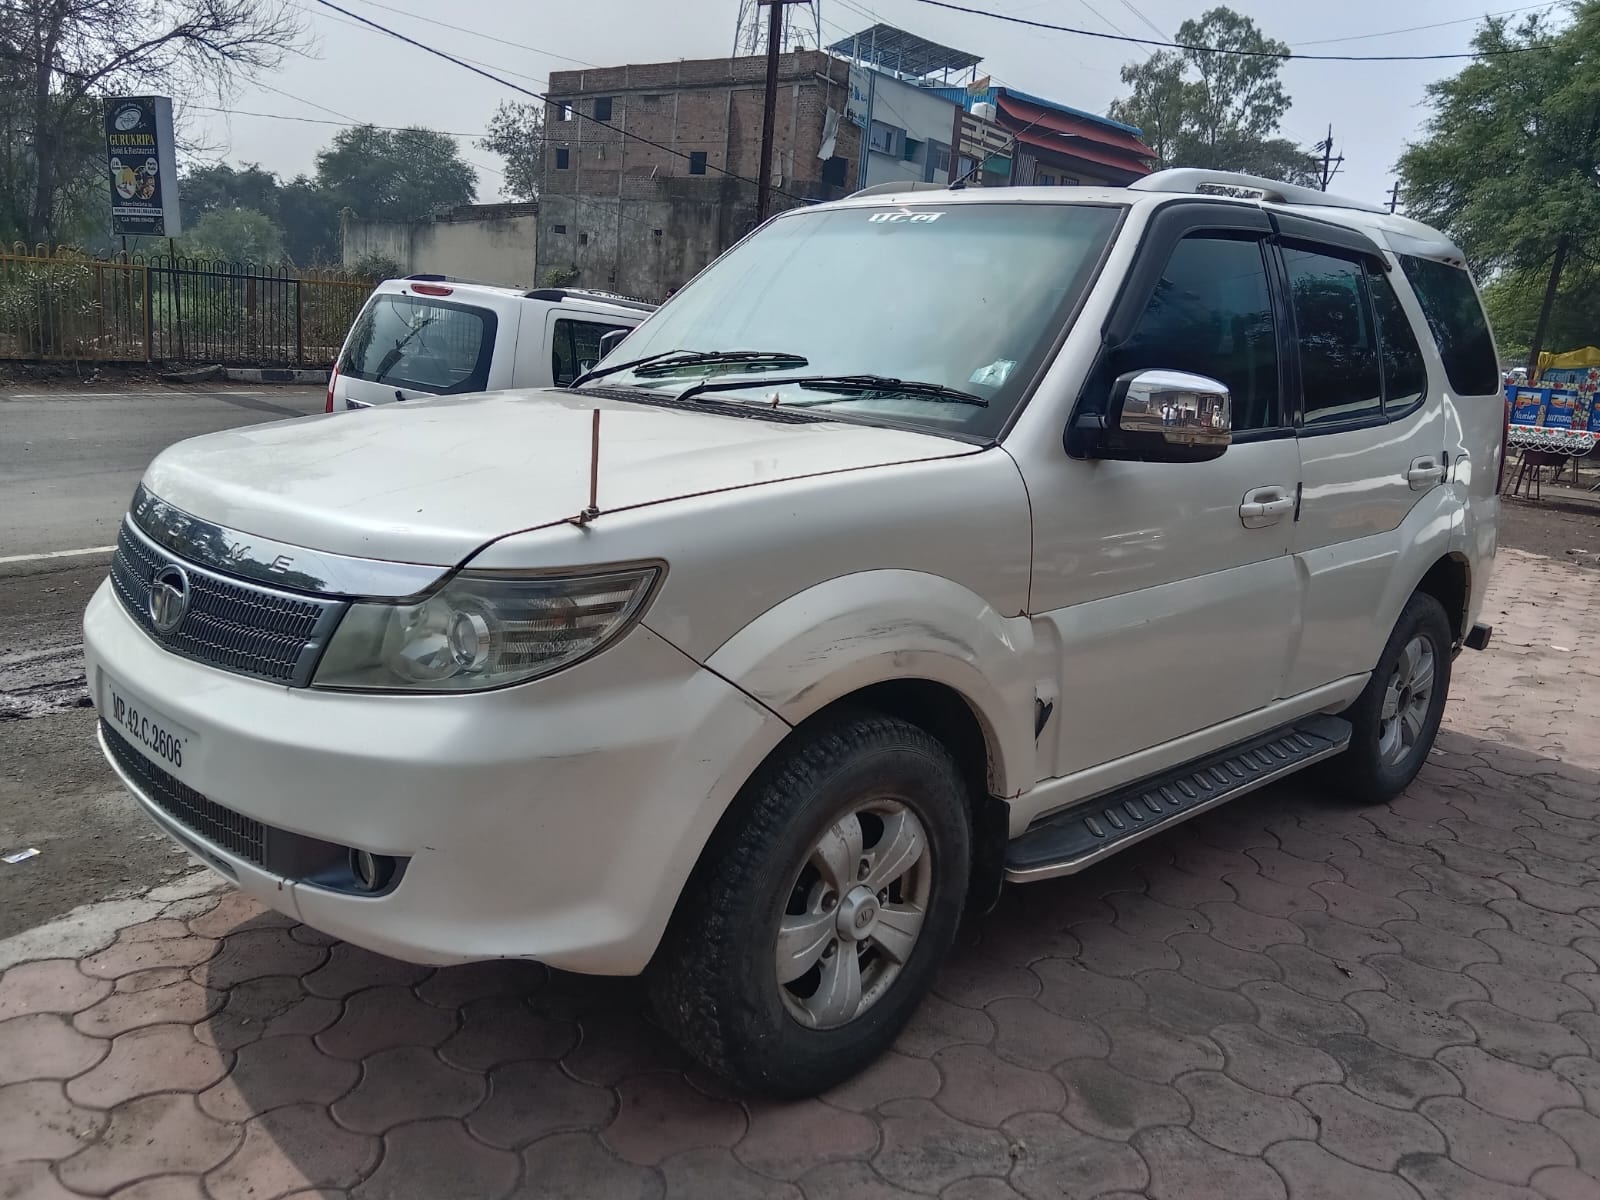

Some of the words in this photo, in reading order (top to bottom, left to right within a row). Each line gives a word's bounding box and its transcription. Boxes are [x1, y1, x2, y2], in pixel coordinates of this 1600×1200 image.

[109, 134, 155, 146] GURUKRIPA
[128, 147, 156, 155] Restaurant
[868, 207, 947, 224] पटेल
